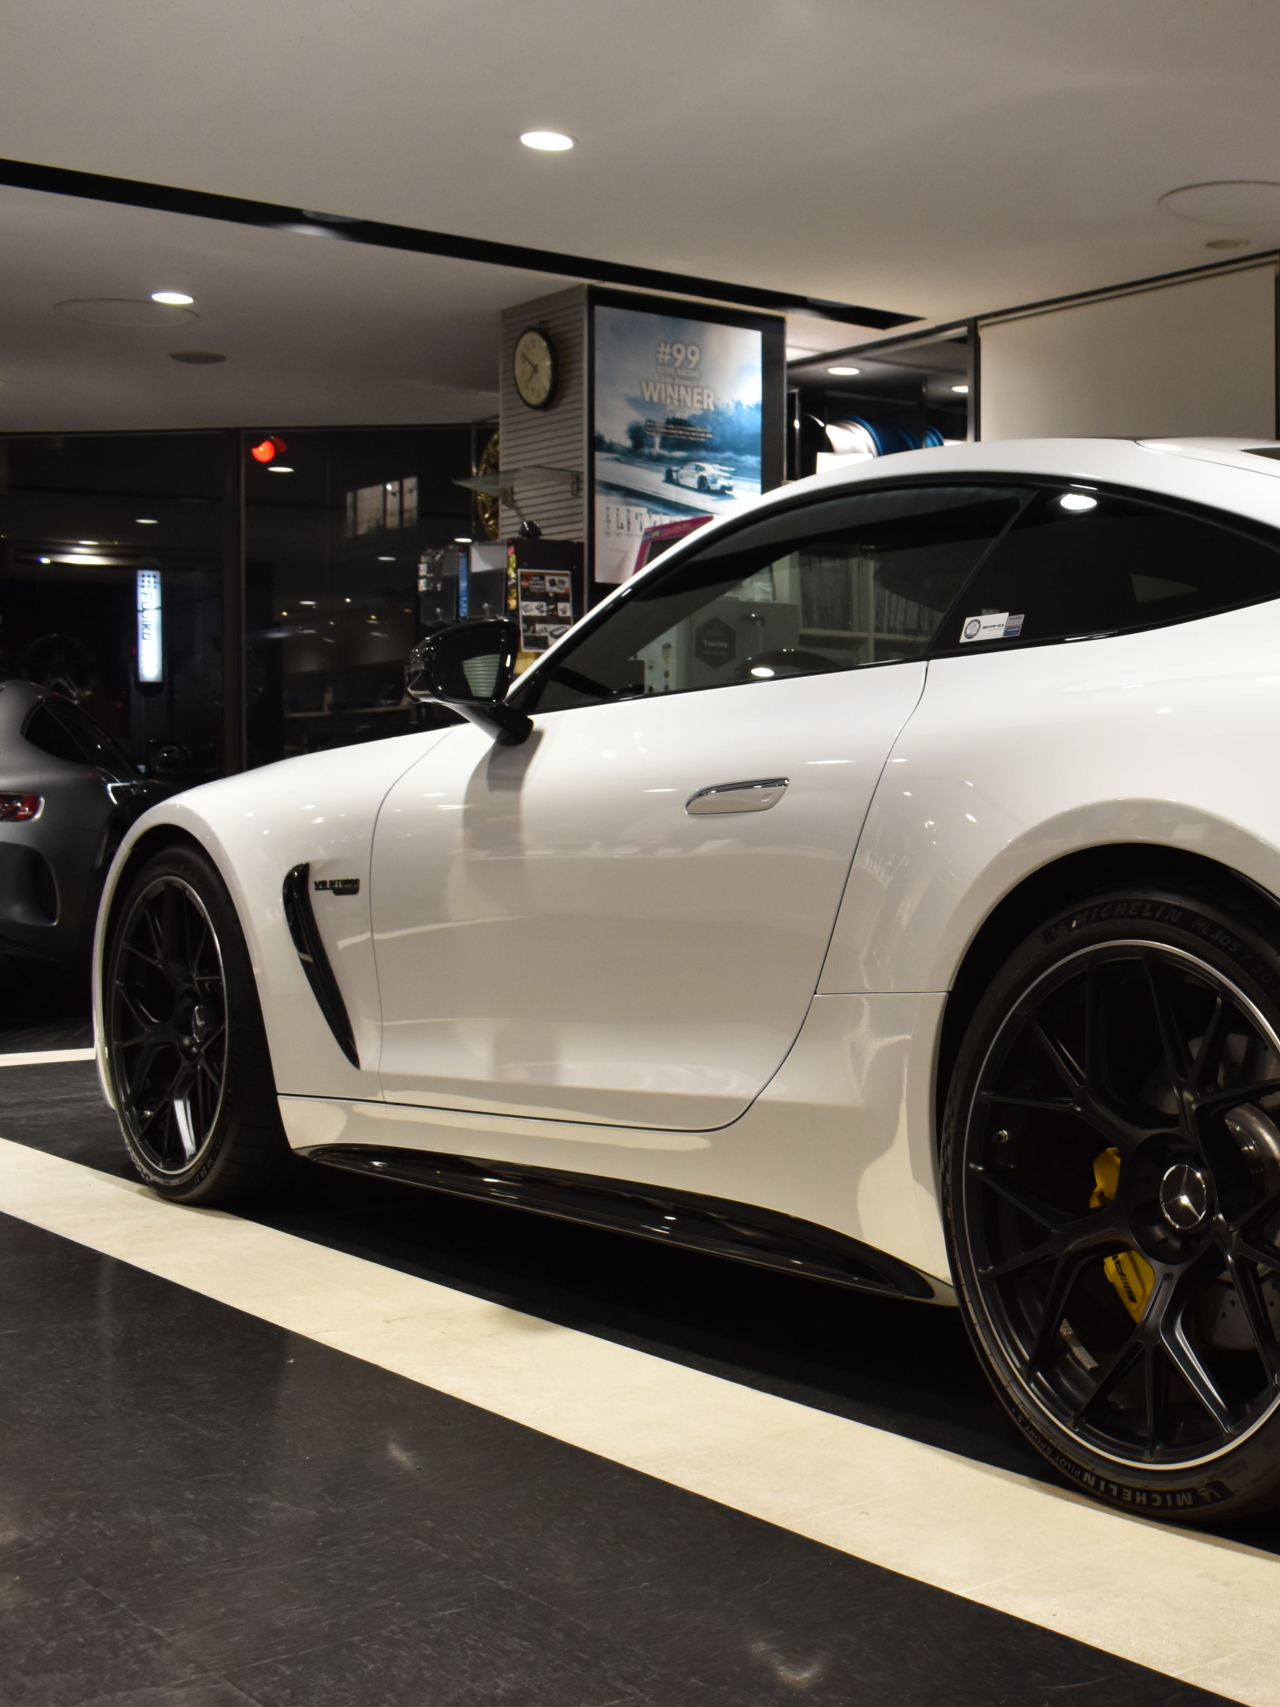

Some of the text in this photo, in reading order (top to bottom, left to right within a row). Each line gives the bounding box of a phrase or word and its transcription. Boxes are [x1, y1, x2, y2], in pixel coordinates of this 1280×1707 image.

[656, 342, 700, 369] #99
[641, 381, 715, 411] WINNER
[1074, 902, 1184, 925] MICHELIN
[1024, 1423, 1053, 1455] SPORT
[1054, 1455, 1082, 1477] PILOT
[1081, 1472, 1194, 1508] MICHELIN
